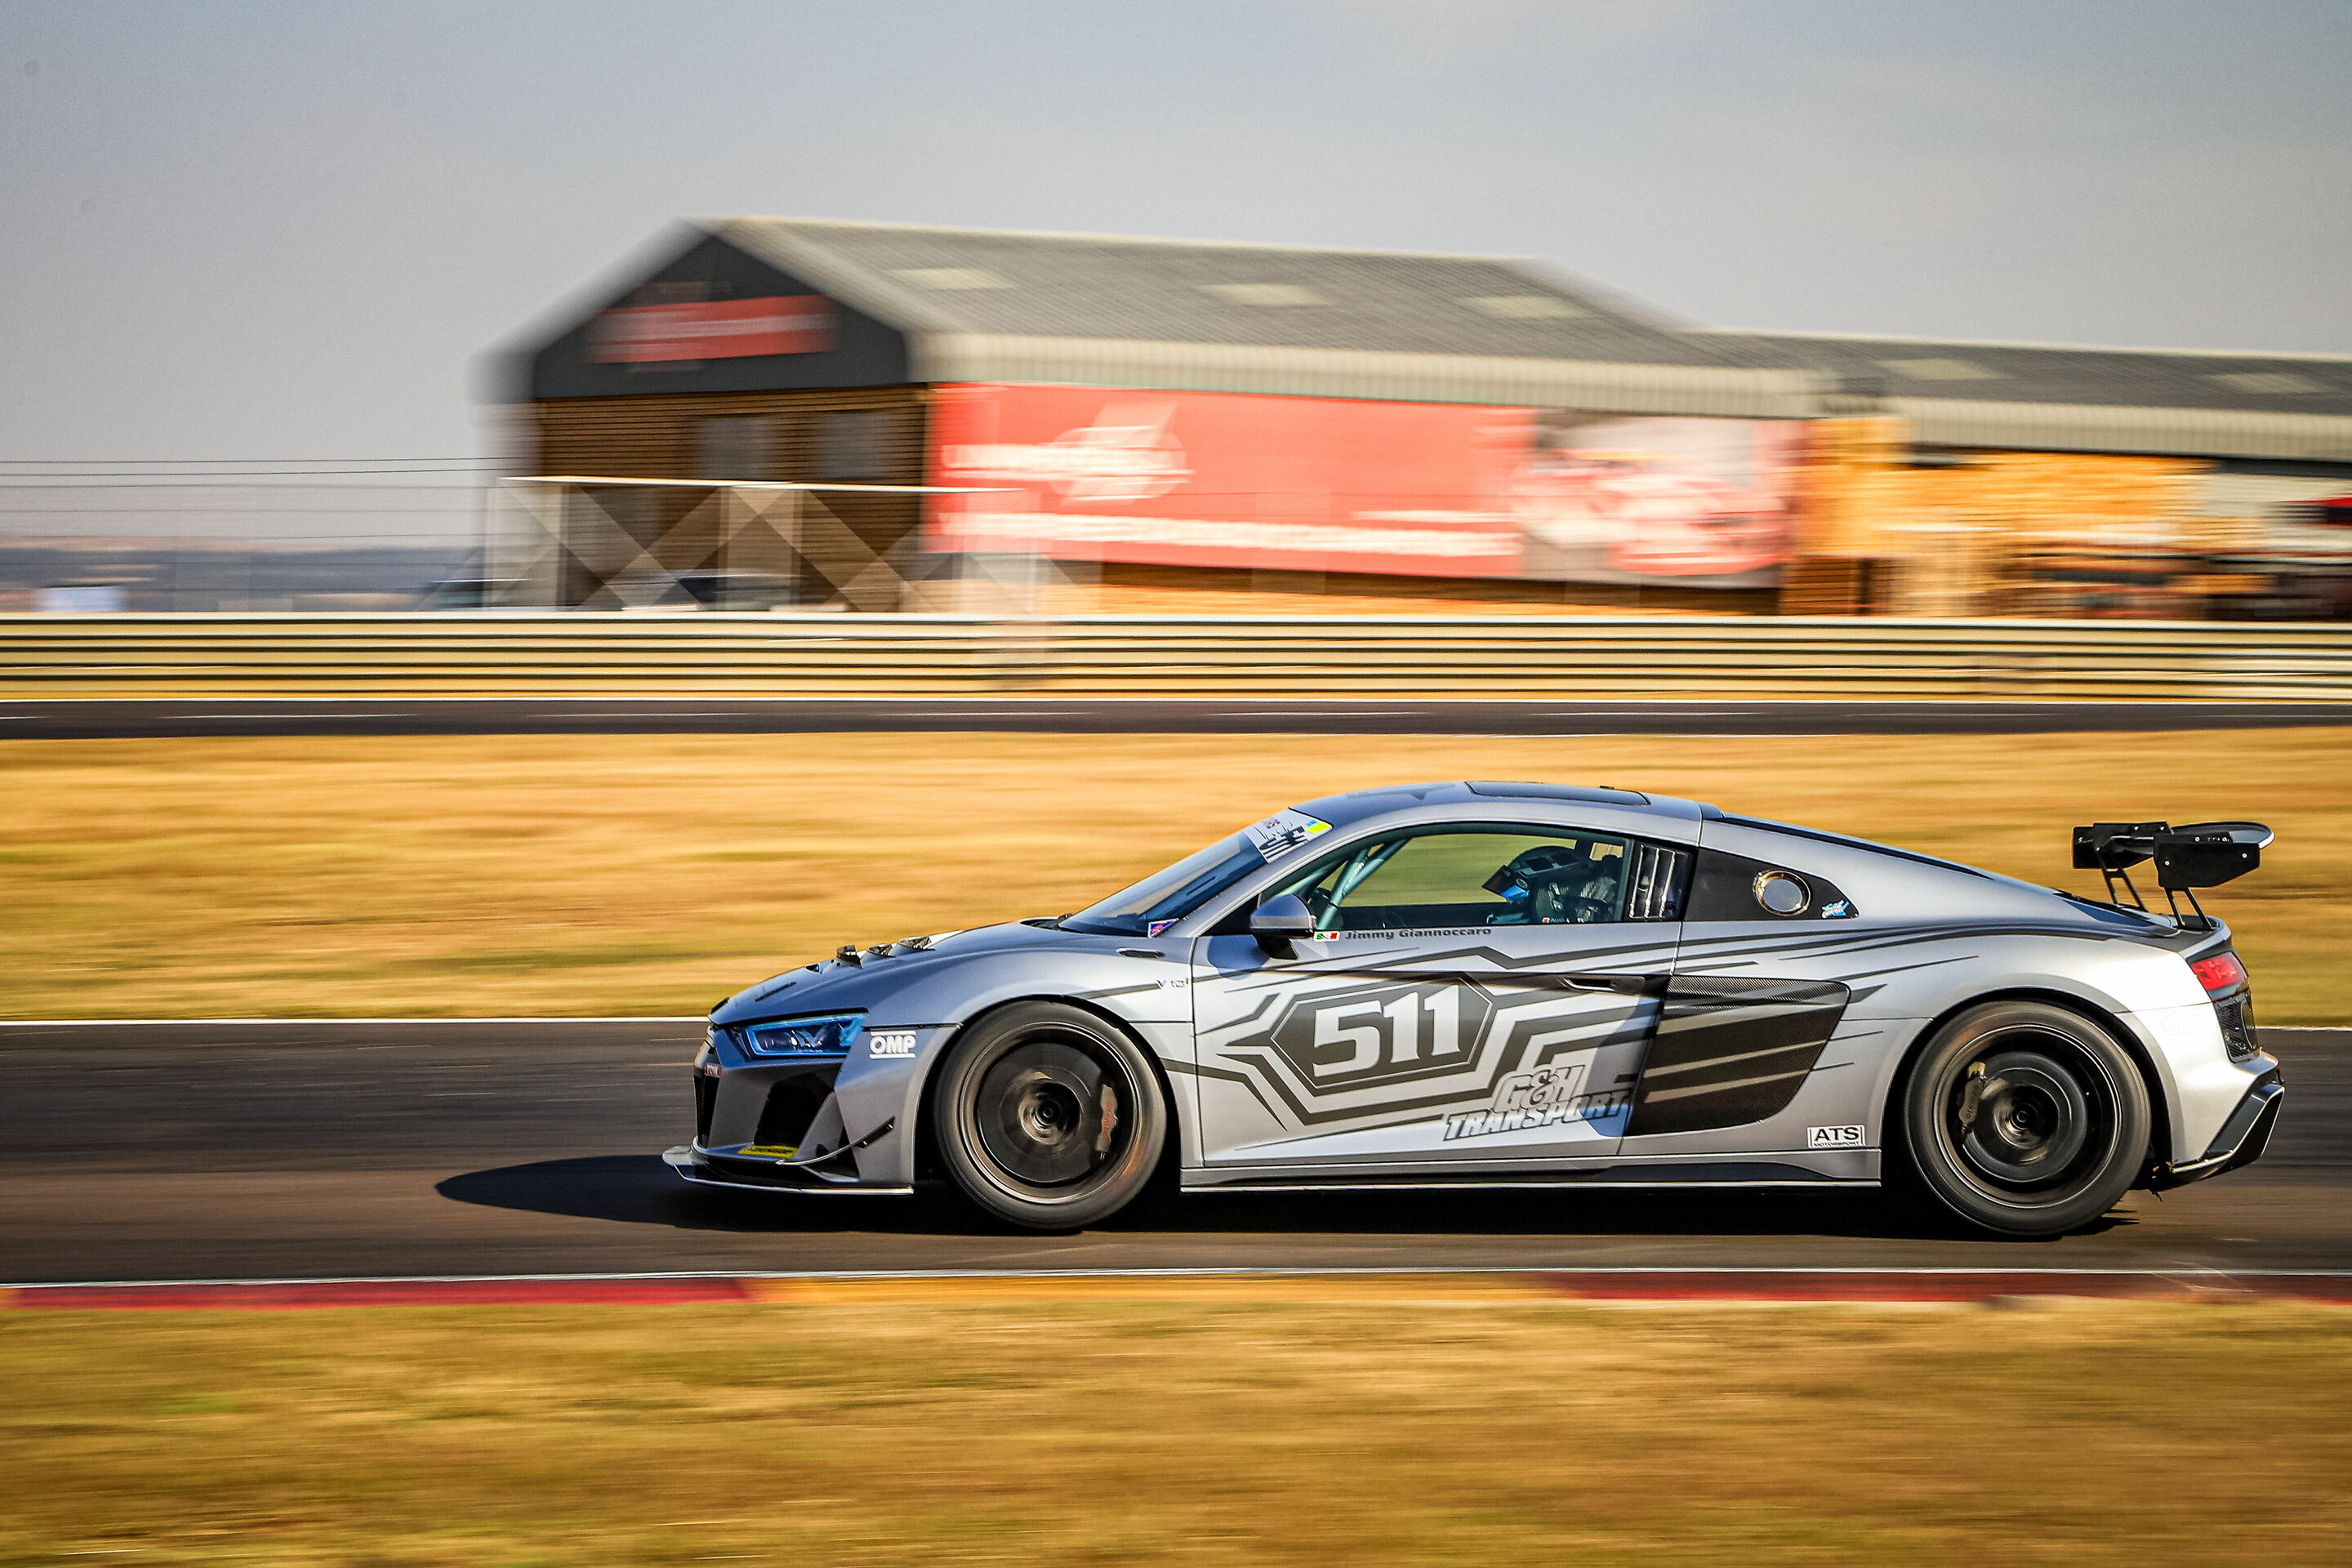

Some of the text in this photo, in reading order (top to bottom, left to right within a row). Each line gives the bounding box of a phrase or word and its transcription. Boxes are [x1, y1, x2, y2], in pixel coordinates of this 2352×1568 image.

[1346, 927, 1491, 940] Jimmy Giannoccaro
[870, 1035, 916, 1054] OMP
[1313, 985, 1461, 1077] 511
[1494, 1064, 1585, 1111] G&H
[1443, 1089, 1632, 1141] TRANSPORT
[1815, 1127, 1859, 1141] ATS
